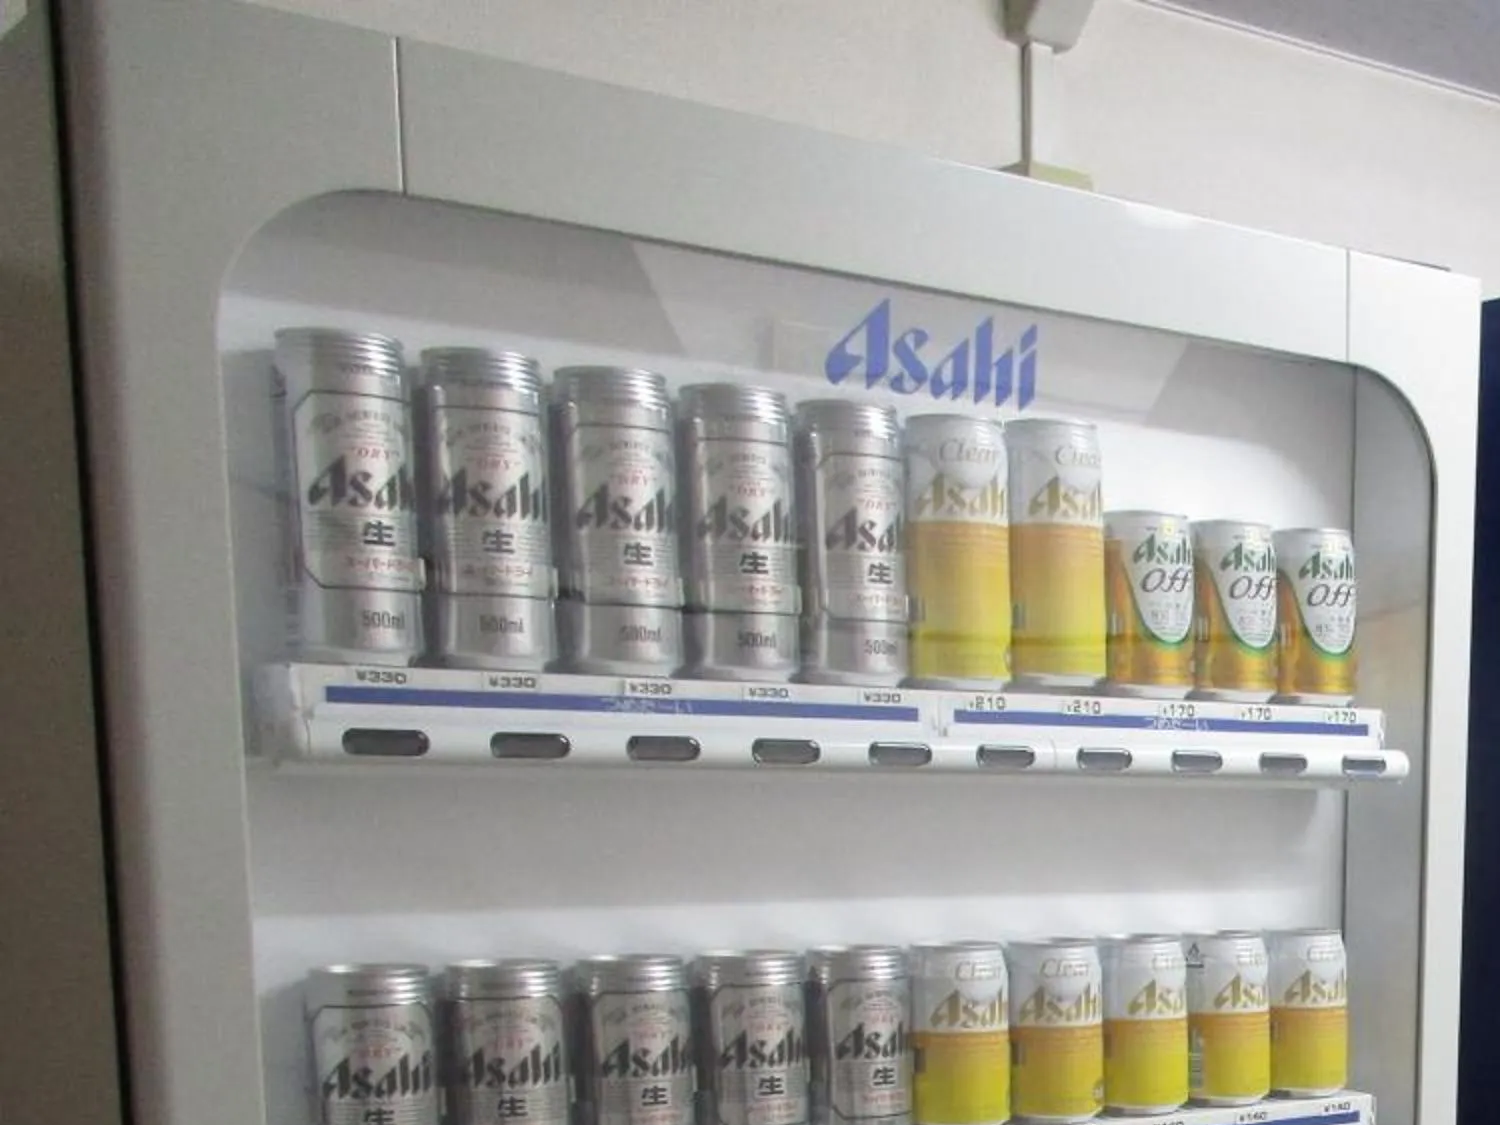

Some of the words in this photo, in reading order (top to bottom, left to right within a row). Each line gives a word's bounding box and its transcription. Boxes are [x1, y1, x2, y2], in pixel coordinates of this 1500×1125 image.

[824, 297, 1038, 411] Asahi
[363, 520, 396, 547] 生
[481, 529, 515, 554] 生
[623, 542, 653, 565] 生
[738, 552, 769, 576] 生
[867, 562, 893, 585] 生
[1142, 567, 1193, 593] Off
[1229, 575, 1278, 600] Off
[1307, 582, 1355, 607] Off
[759, 1076, 784, 1096] 生
[873, 1067, 896, 1086] 生
[498, 1096, 529, 1118] 生
[642, 1085, 668, 1106] 生
